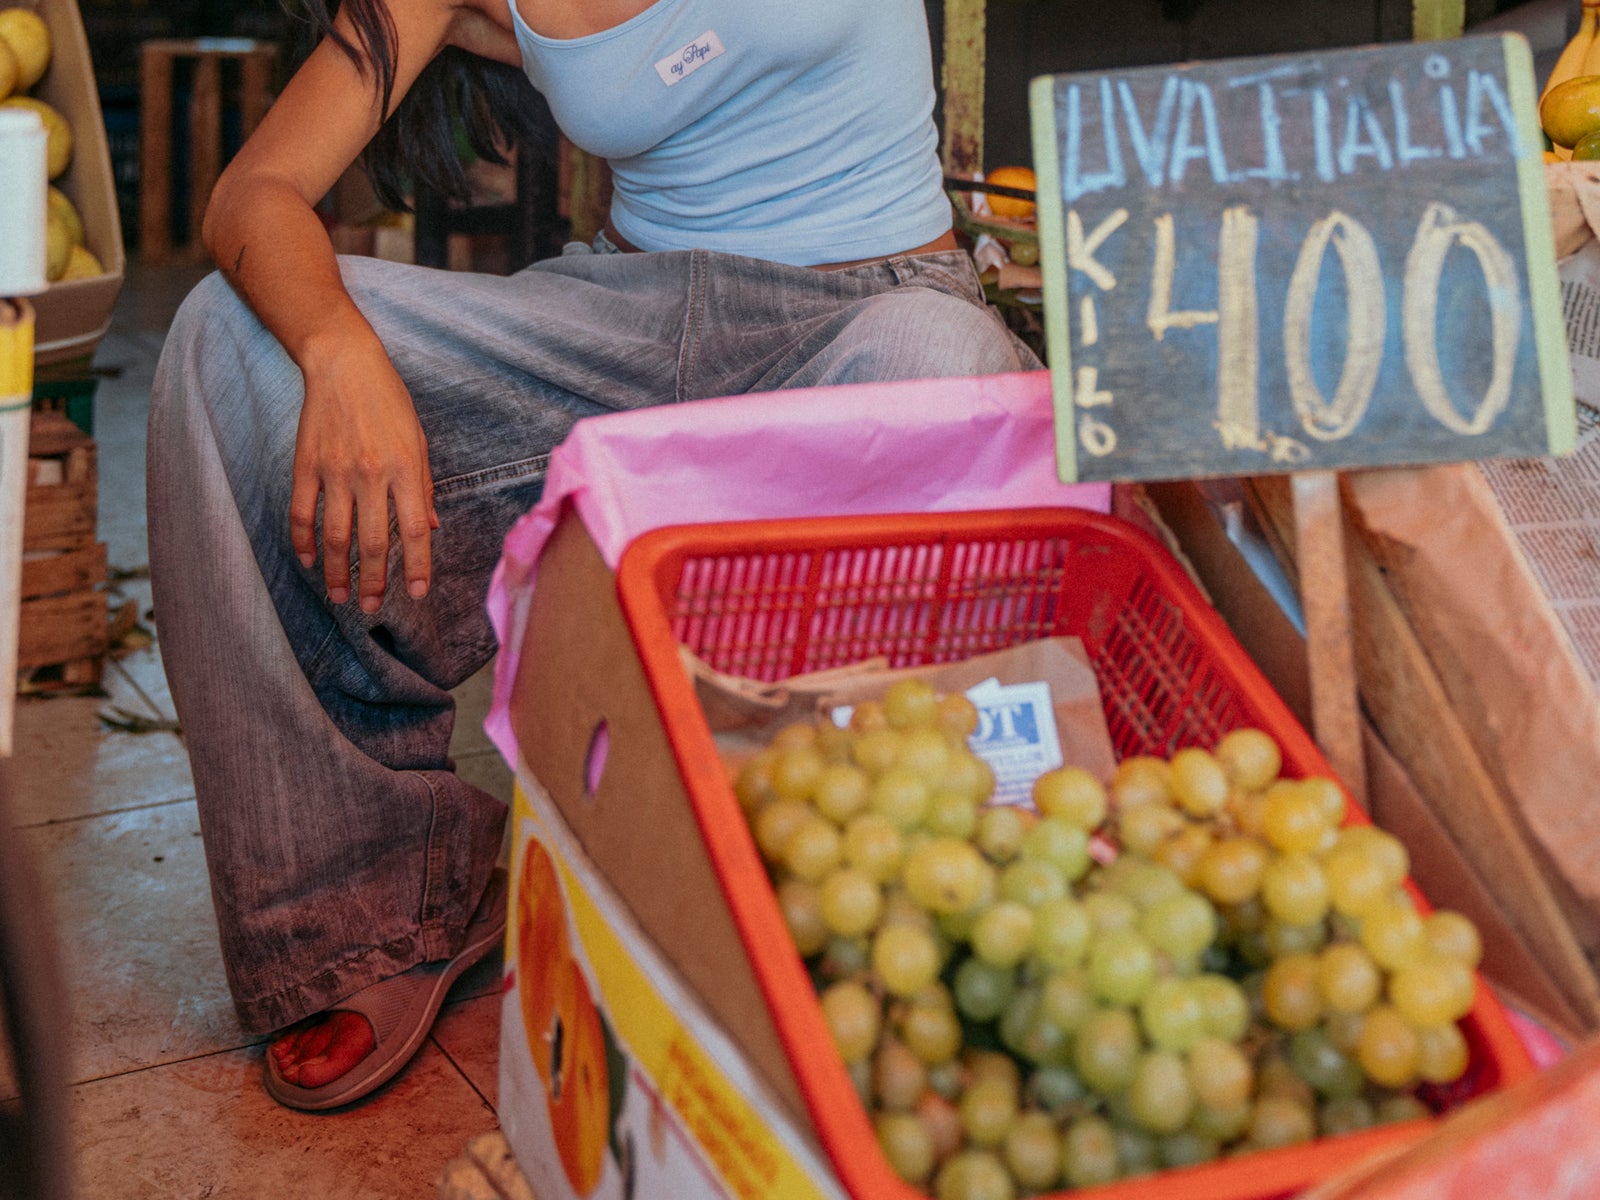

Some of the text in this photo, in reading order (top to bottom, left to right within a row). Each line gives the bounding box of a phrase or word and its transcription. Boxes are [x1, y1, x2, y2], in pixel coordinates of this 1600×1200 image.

[670, 43, 711, 75] ay Papi
[1063, 73, 1229, 203] UVA
